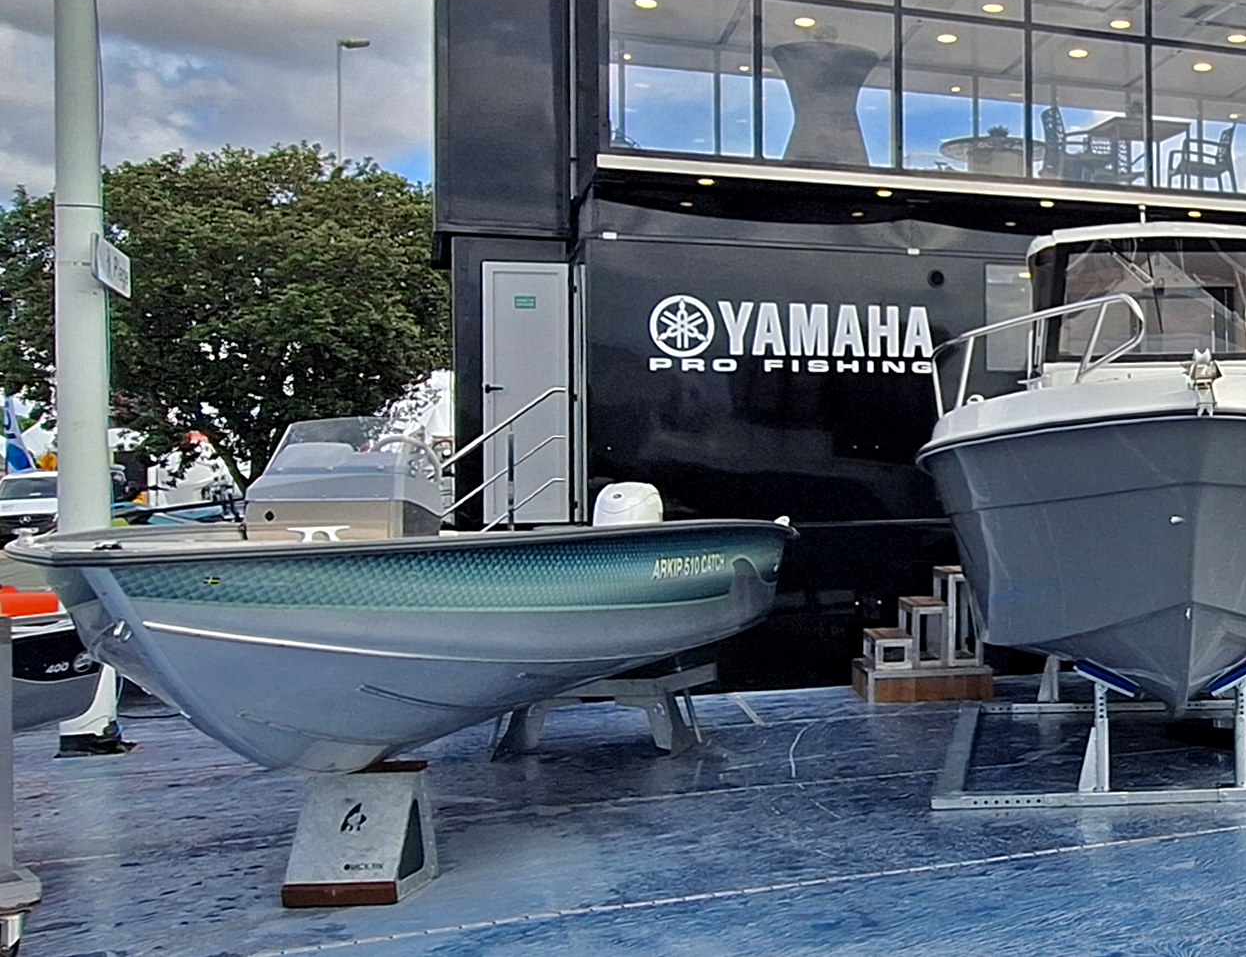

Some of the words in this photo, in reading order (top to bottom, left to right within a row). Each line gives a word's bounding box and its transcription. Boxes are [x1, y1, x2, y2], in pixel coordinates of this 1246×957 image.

[718, 300, 935, 358] YAMAHA
[649, 357, 737, 372] PRO
[763, 359, 934, 374] FISHING
[652, 558, 683, 579] ARKIP
[684, 556, 700, 576] 510
[701, 553, 726, 573] CATCH
[45, 661, 70, 674] 400
